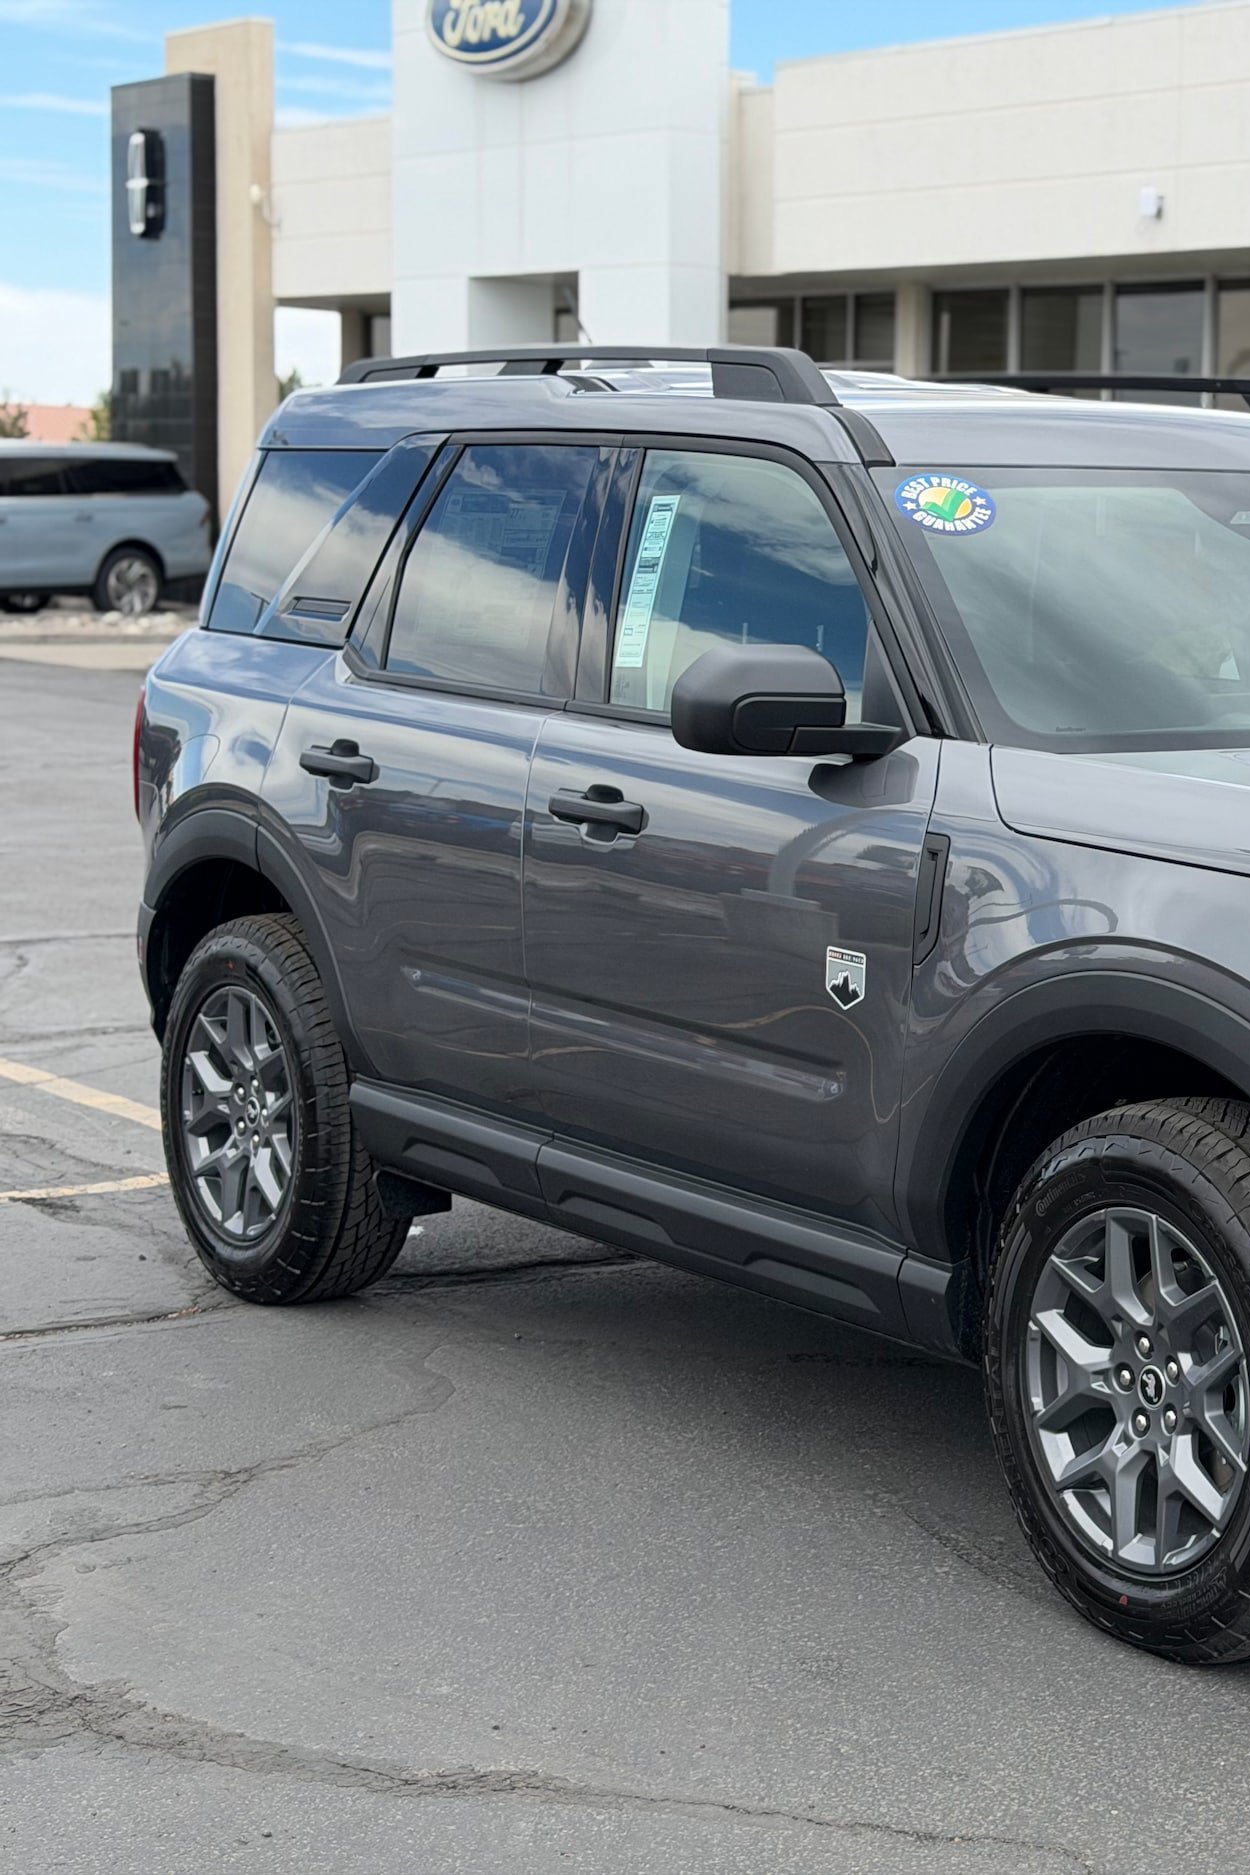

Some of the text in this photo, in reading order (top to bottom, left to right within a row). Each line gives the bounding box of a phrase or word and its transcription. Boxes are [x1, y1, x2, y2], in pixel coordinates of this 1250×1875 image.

[443, 0, 526, 48] Ford
[901, 476, 978, 500] BEST PRICE
[912, 507, 992, 532] GUARANTEE
